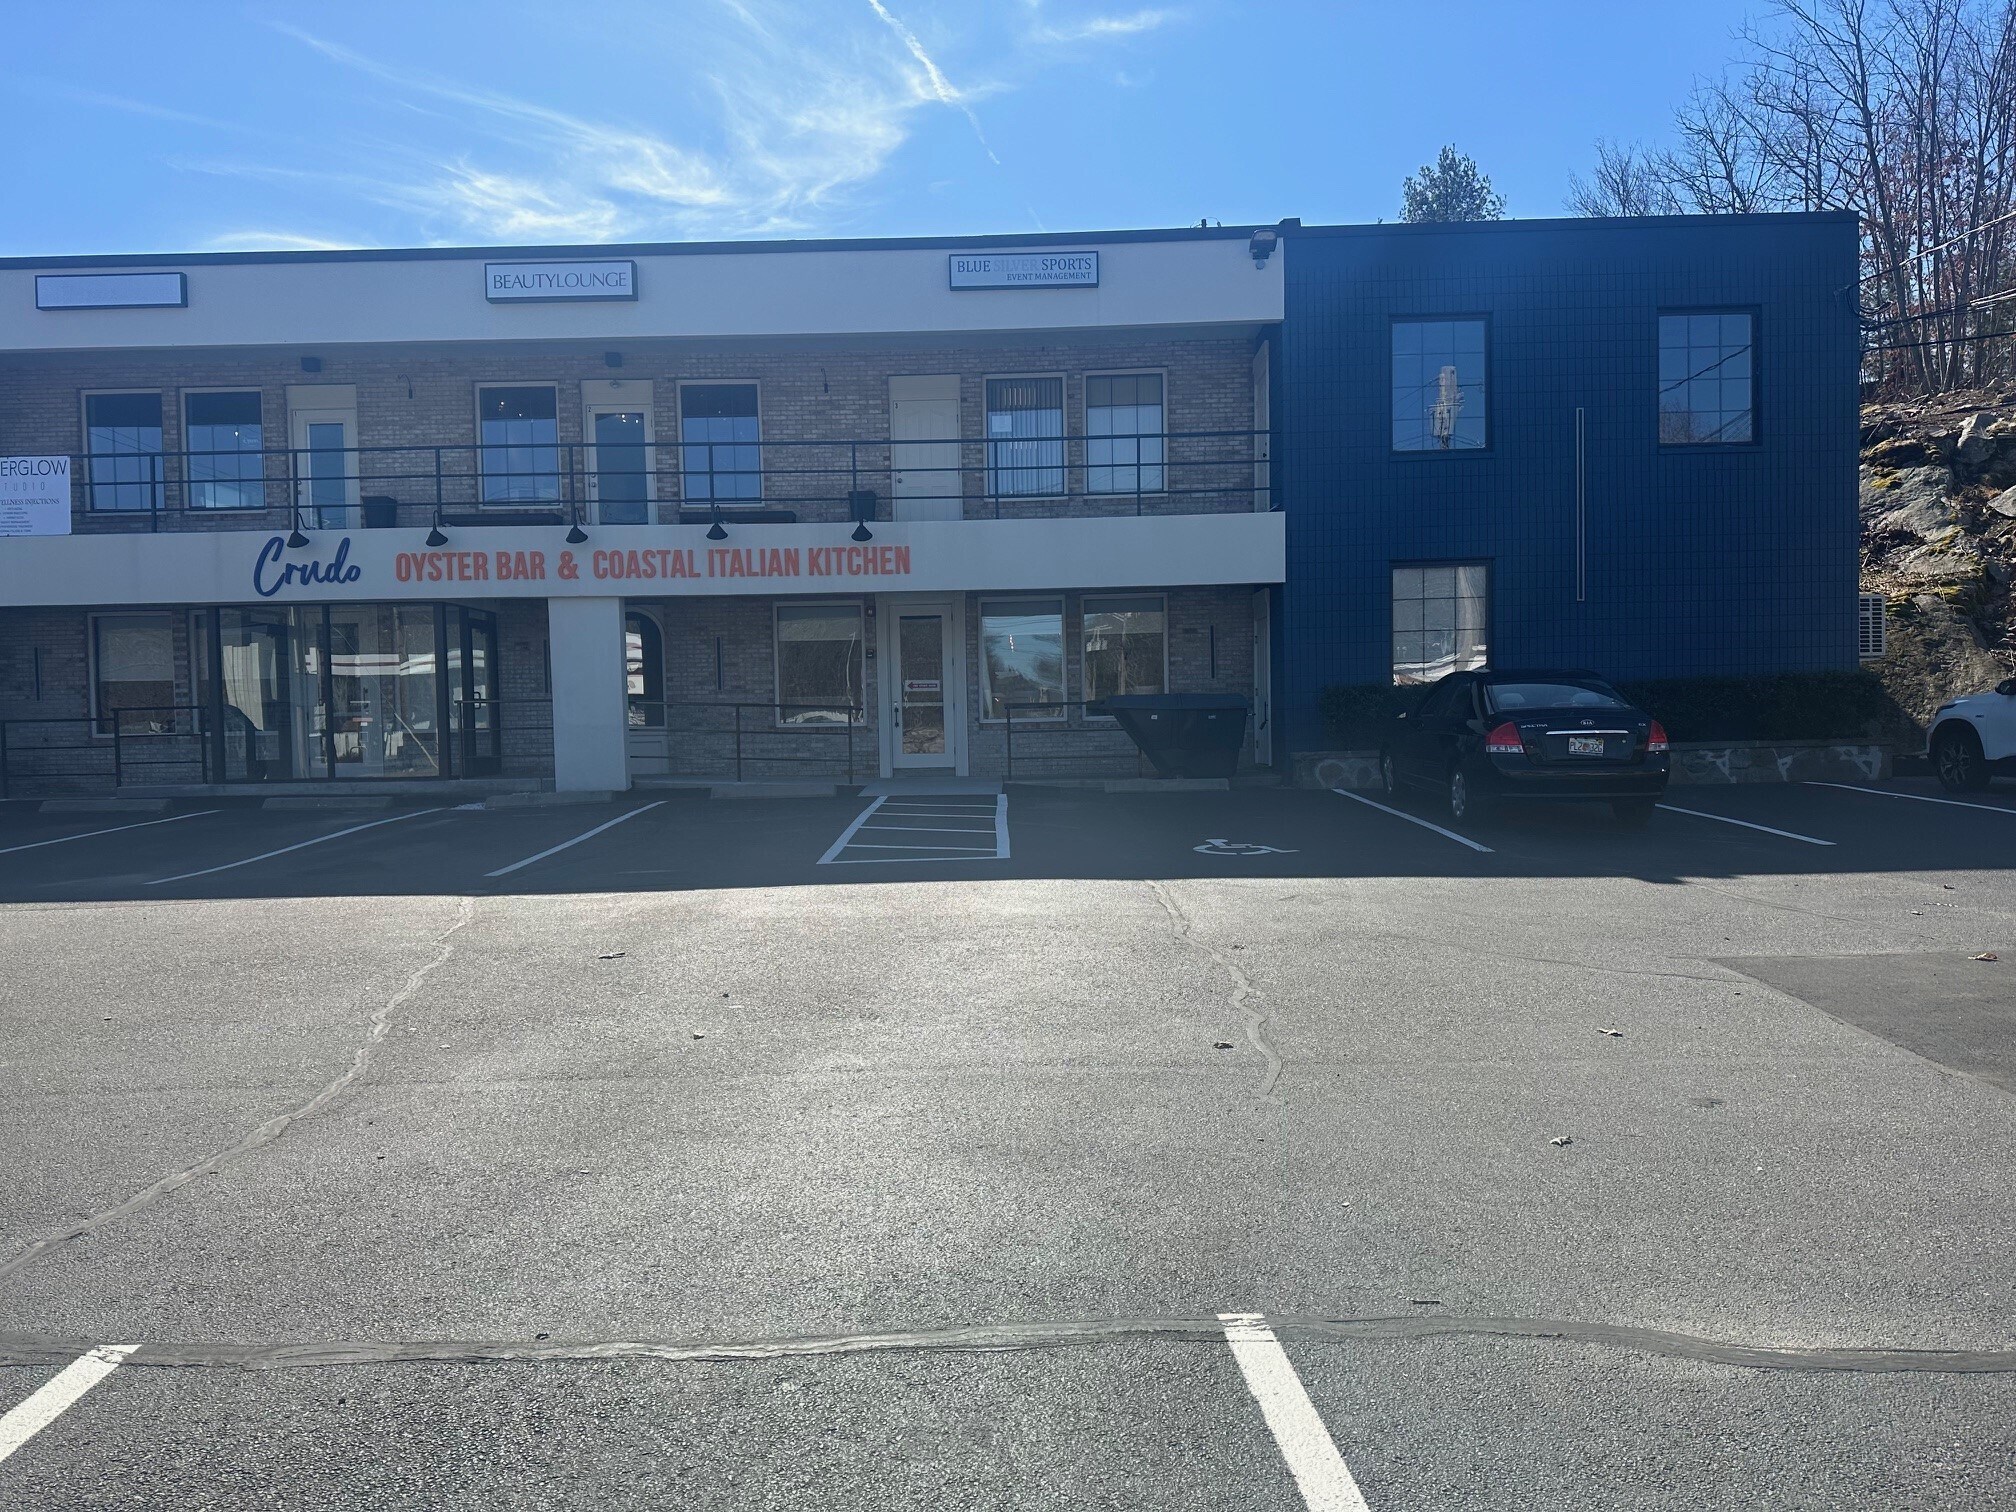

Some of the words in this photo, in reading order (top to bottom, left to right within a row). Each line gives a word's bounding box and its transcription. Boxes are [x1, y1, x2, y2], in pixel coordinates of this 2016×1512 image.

[957, 260, 991, 273] BLUE
[993, 258, 1039, 272] SILVER
[1041, 257, 1092, 271] SPORTS
[493, 272, 627, 289] BEAUTYLOUNGE
[1007, 273, 1033, 281] EVENT
[1034, 272, 1092, 281] MANAGEMENT
[25, 498, 60, 506] INJECTIONS
[253, 536, 361, 597] Crudo
[395, 551, 489, 582] OYSTER
[496, 551, 546, 580] BAR
[558, 550, 580, 580] &
[593, 549, 701, 580] COASTAL
[708, 548, 800, 578] ITALIAN
[808, 546, 911, 576] KITCHEN
